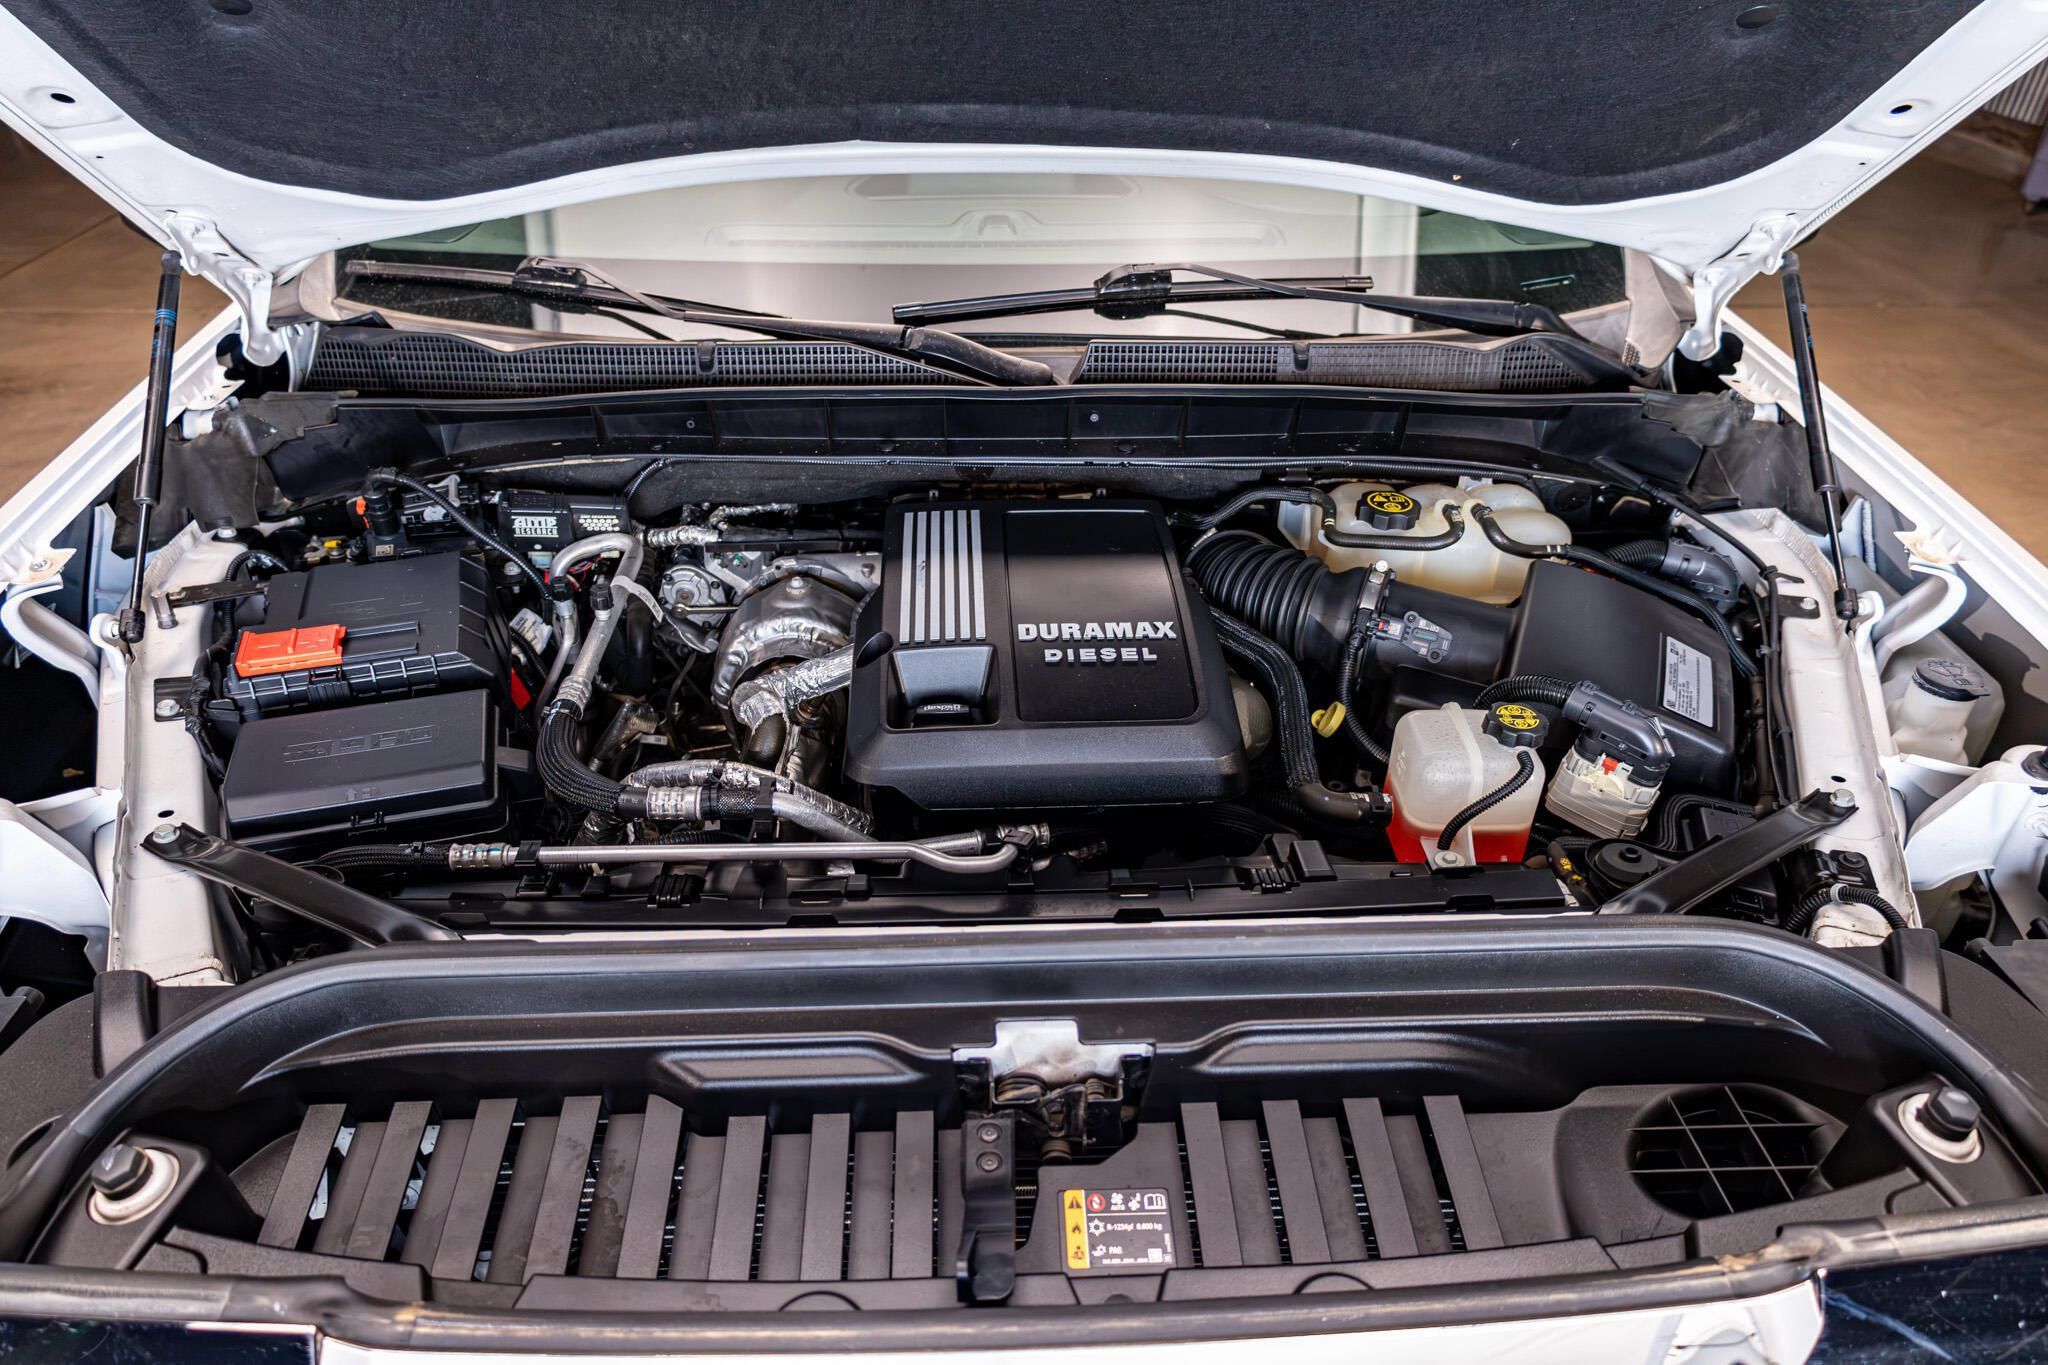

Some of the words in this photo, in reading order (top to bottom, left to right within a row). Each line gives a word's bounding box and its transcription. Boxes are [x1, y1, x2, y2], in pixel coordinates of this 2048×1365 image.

[511, 516, 558, 528] AMP
[514, 528, 559, 536] RESEARCH
[1017, 621, 1178, 641] DURAMAX
[1044, 647, 1158, 663] DIESEL
